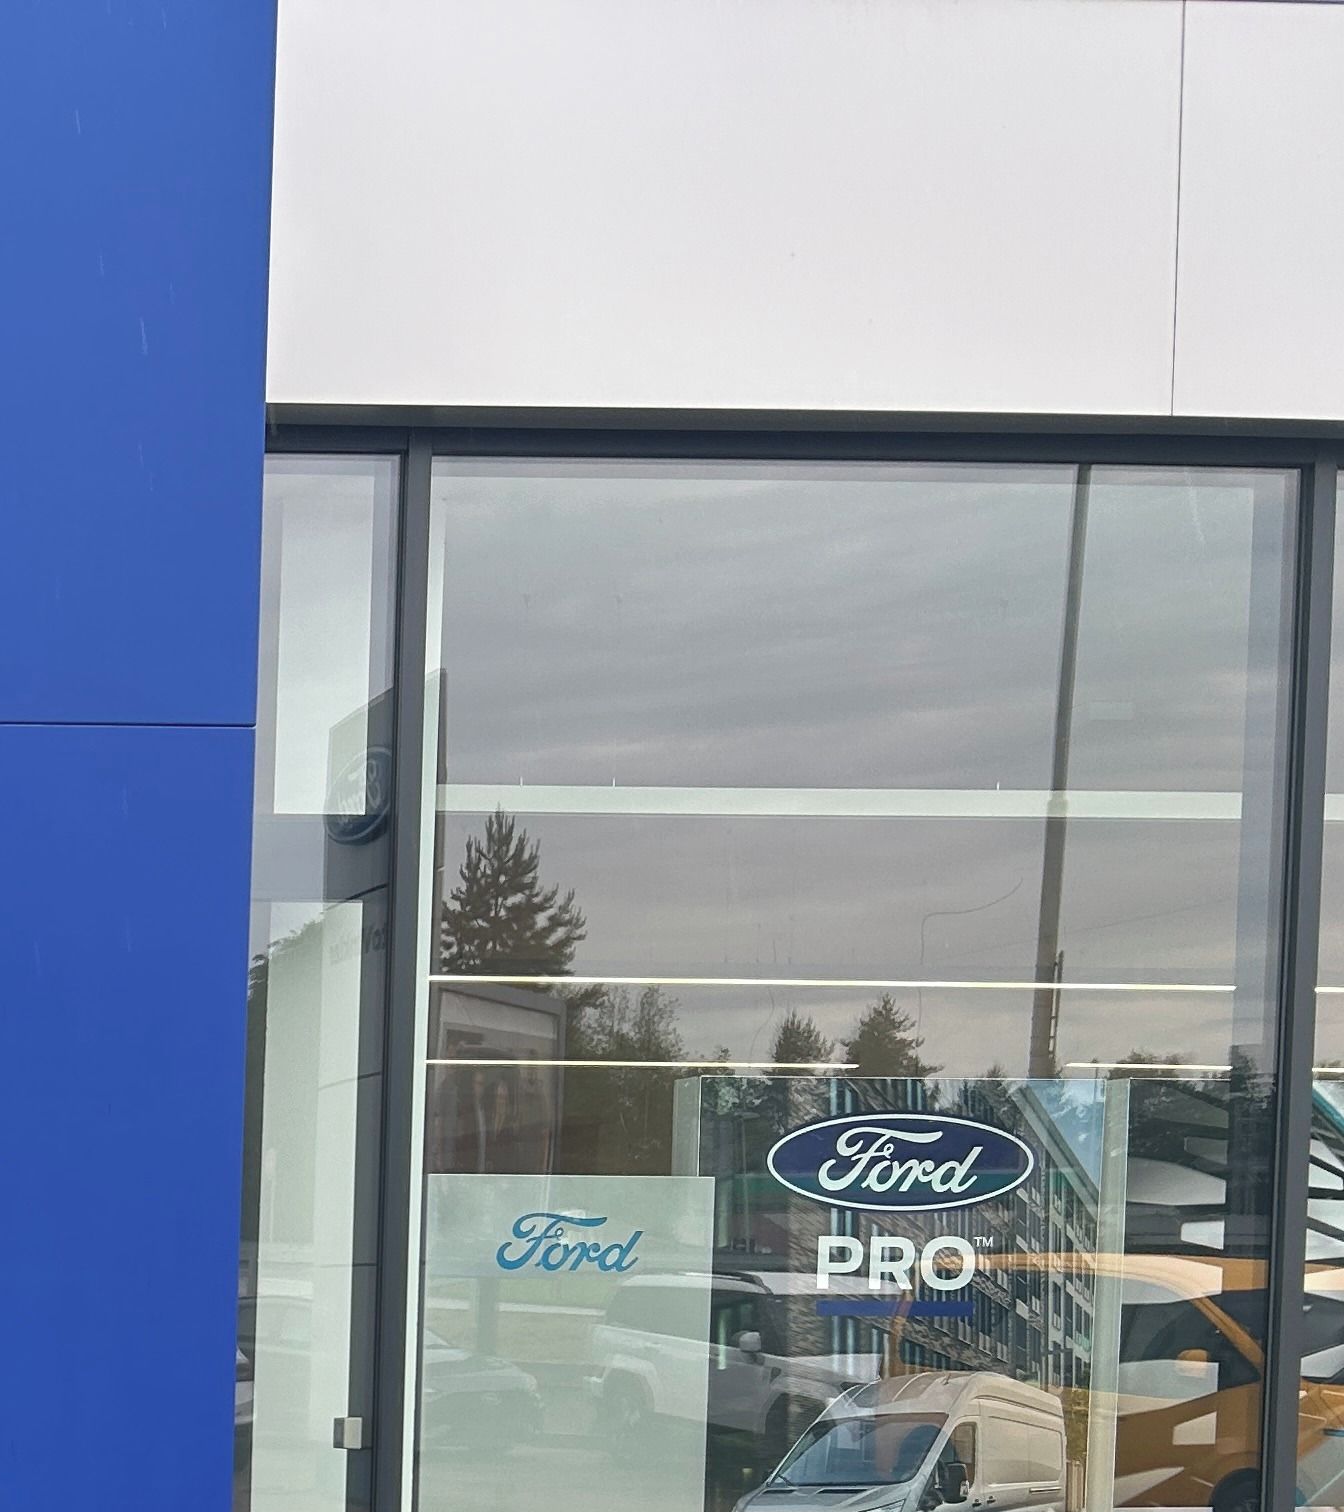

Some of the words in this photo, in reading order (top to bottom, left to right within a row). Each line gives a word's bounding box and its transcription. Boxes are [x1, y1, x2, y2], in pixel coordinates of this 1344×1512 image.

[818, 1126, 983, 1194] Ford
[496, 1213, 644, 1272] Ford
[816, 1235, 976, 1291] PRO
